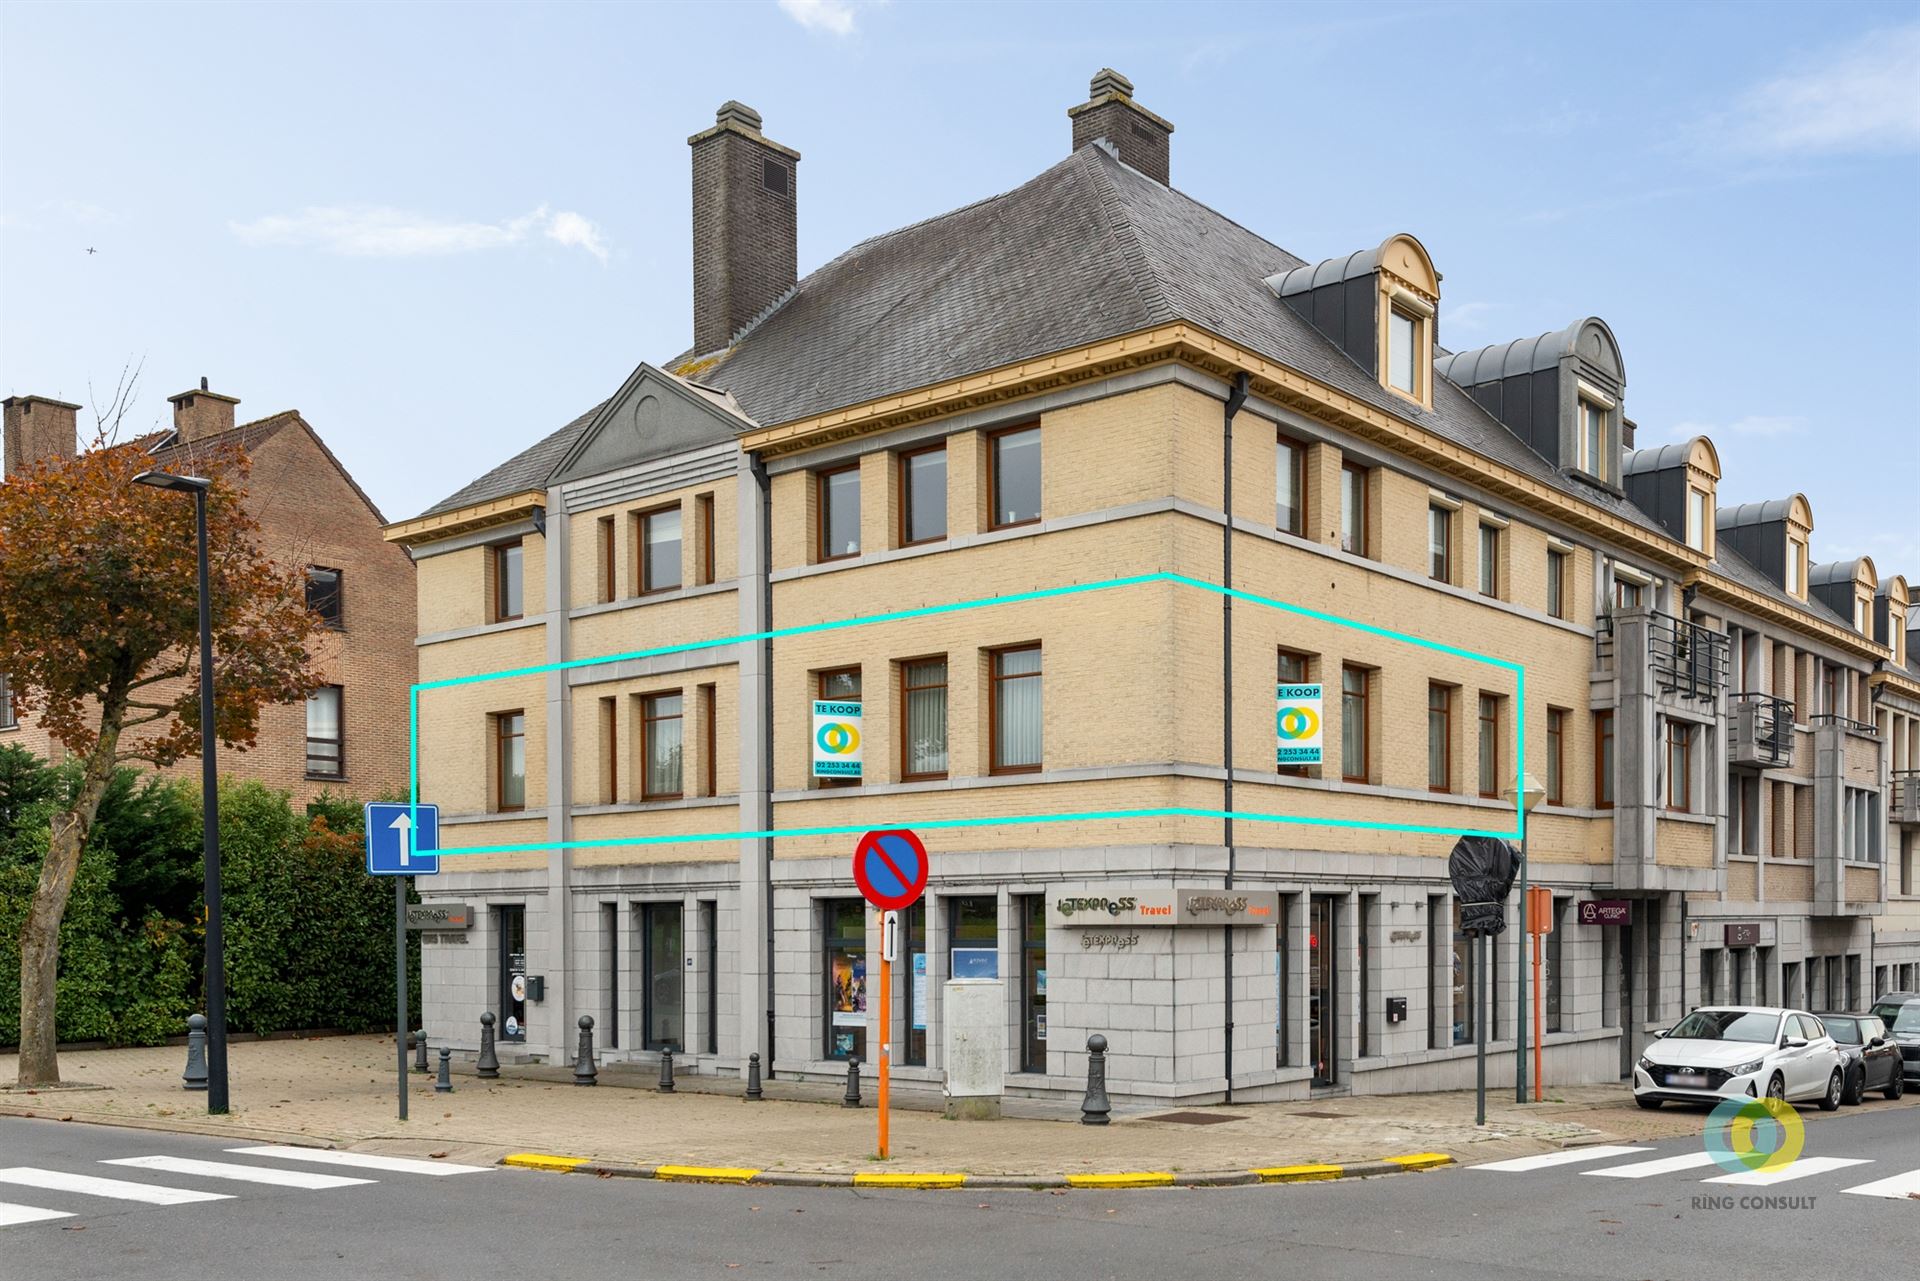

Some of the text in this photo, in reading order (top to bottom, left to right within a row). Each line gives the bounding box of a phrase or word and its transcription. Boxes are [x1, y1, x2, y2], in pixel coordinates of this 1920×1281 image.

[1278, 688, 1320, 696] E KOOP
[816, 704, 860, 714] TE KOOP
[1140, 904, 1172, 915] Travel
